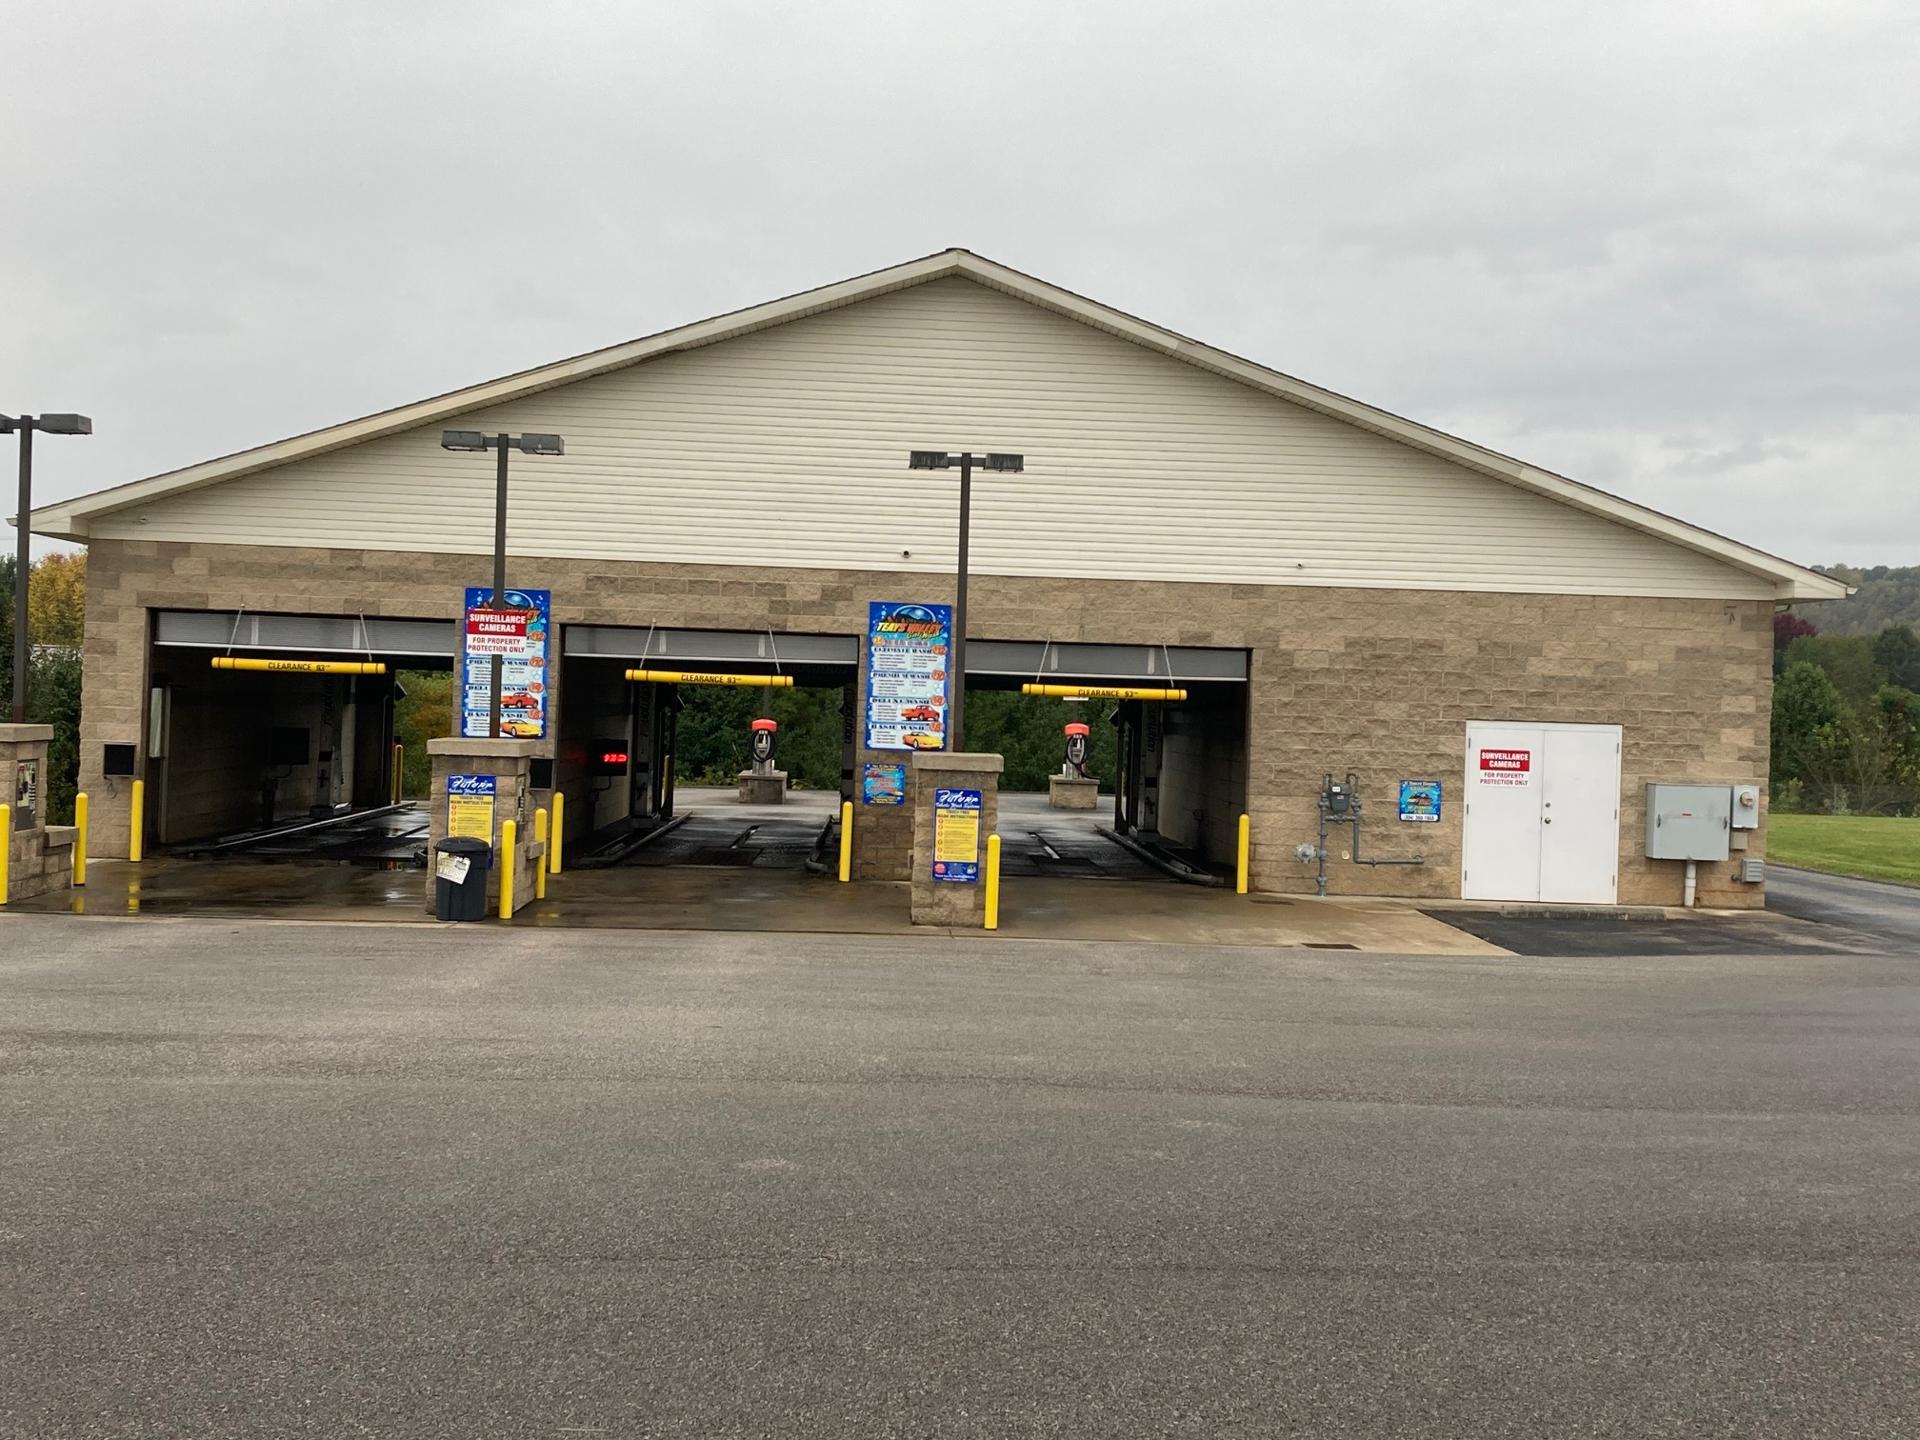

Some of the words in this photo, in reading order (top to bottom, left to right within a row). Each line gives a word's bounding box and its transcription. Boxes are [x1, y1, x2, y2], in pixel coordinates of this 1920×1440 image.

[469, 613, 526, 624] SURVEILLANCE
[478, 623, 516, 632] CAMERAS
[877, 622, 908, 632] TEAYS
[487, 637, 521, 645] PROPERTY
[268, 662, 312, 670] CLEARANCE
[681, 674, 724, 683] CLEARANCE
[1078, 689, 1120, 697] CLEARANCE
[1481, 752, 1529, 760] SURVEILLANCE
[1489, 760, 1521, 768] CAMERAS
